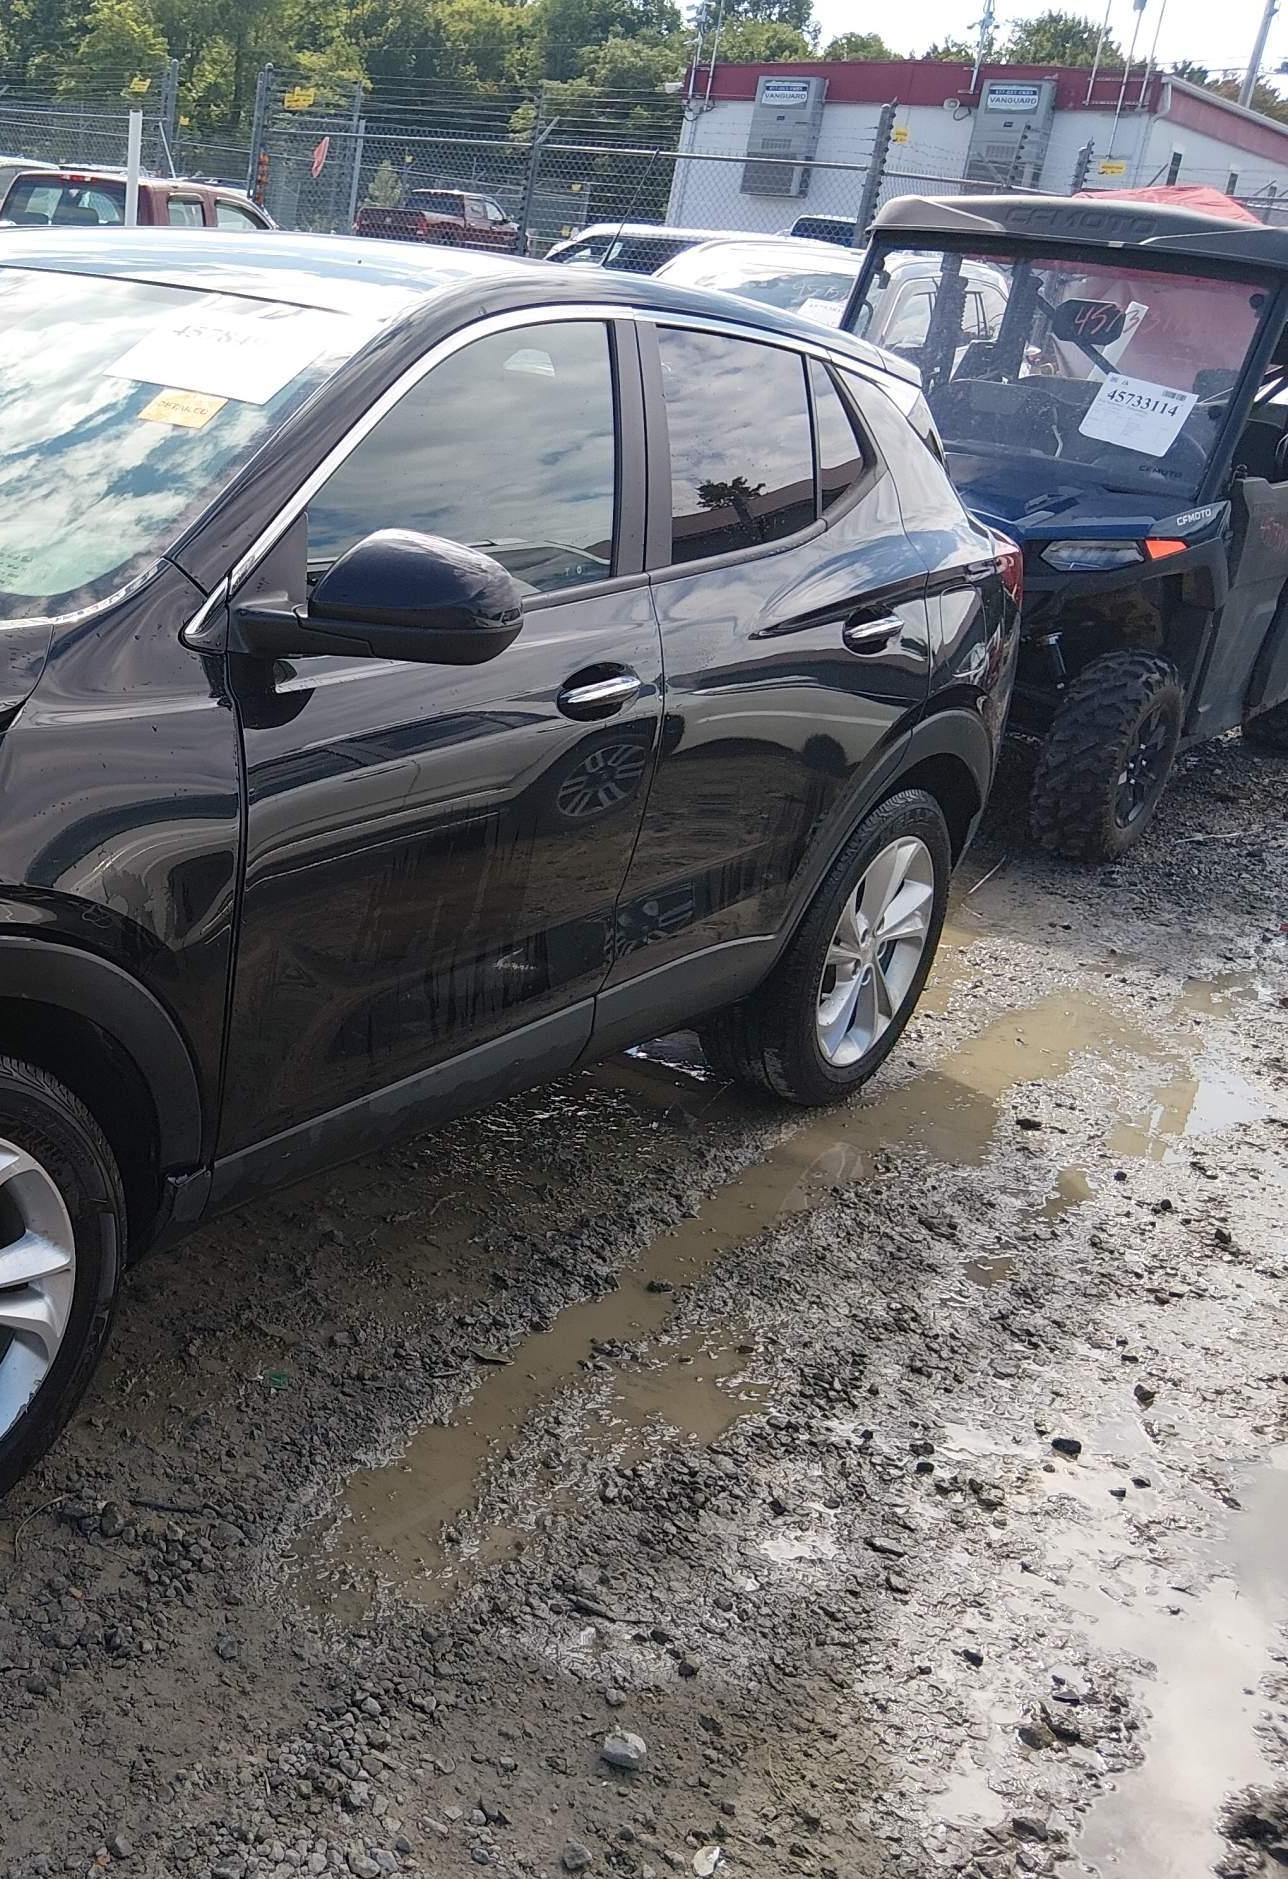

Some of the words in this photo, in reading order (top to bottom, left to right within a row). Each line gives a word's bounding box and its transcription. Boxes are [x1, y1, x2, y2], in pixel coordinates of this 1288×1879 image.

[990, 96, 1037, 105] VANGUARD
[1107, 389, 1179, 417] 45733114
[1176, 508, 1211, 526] CFMOTO
